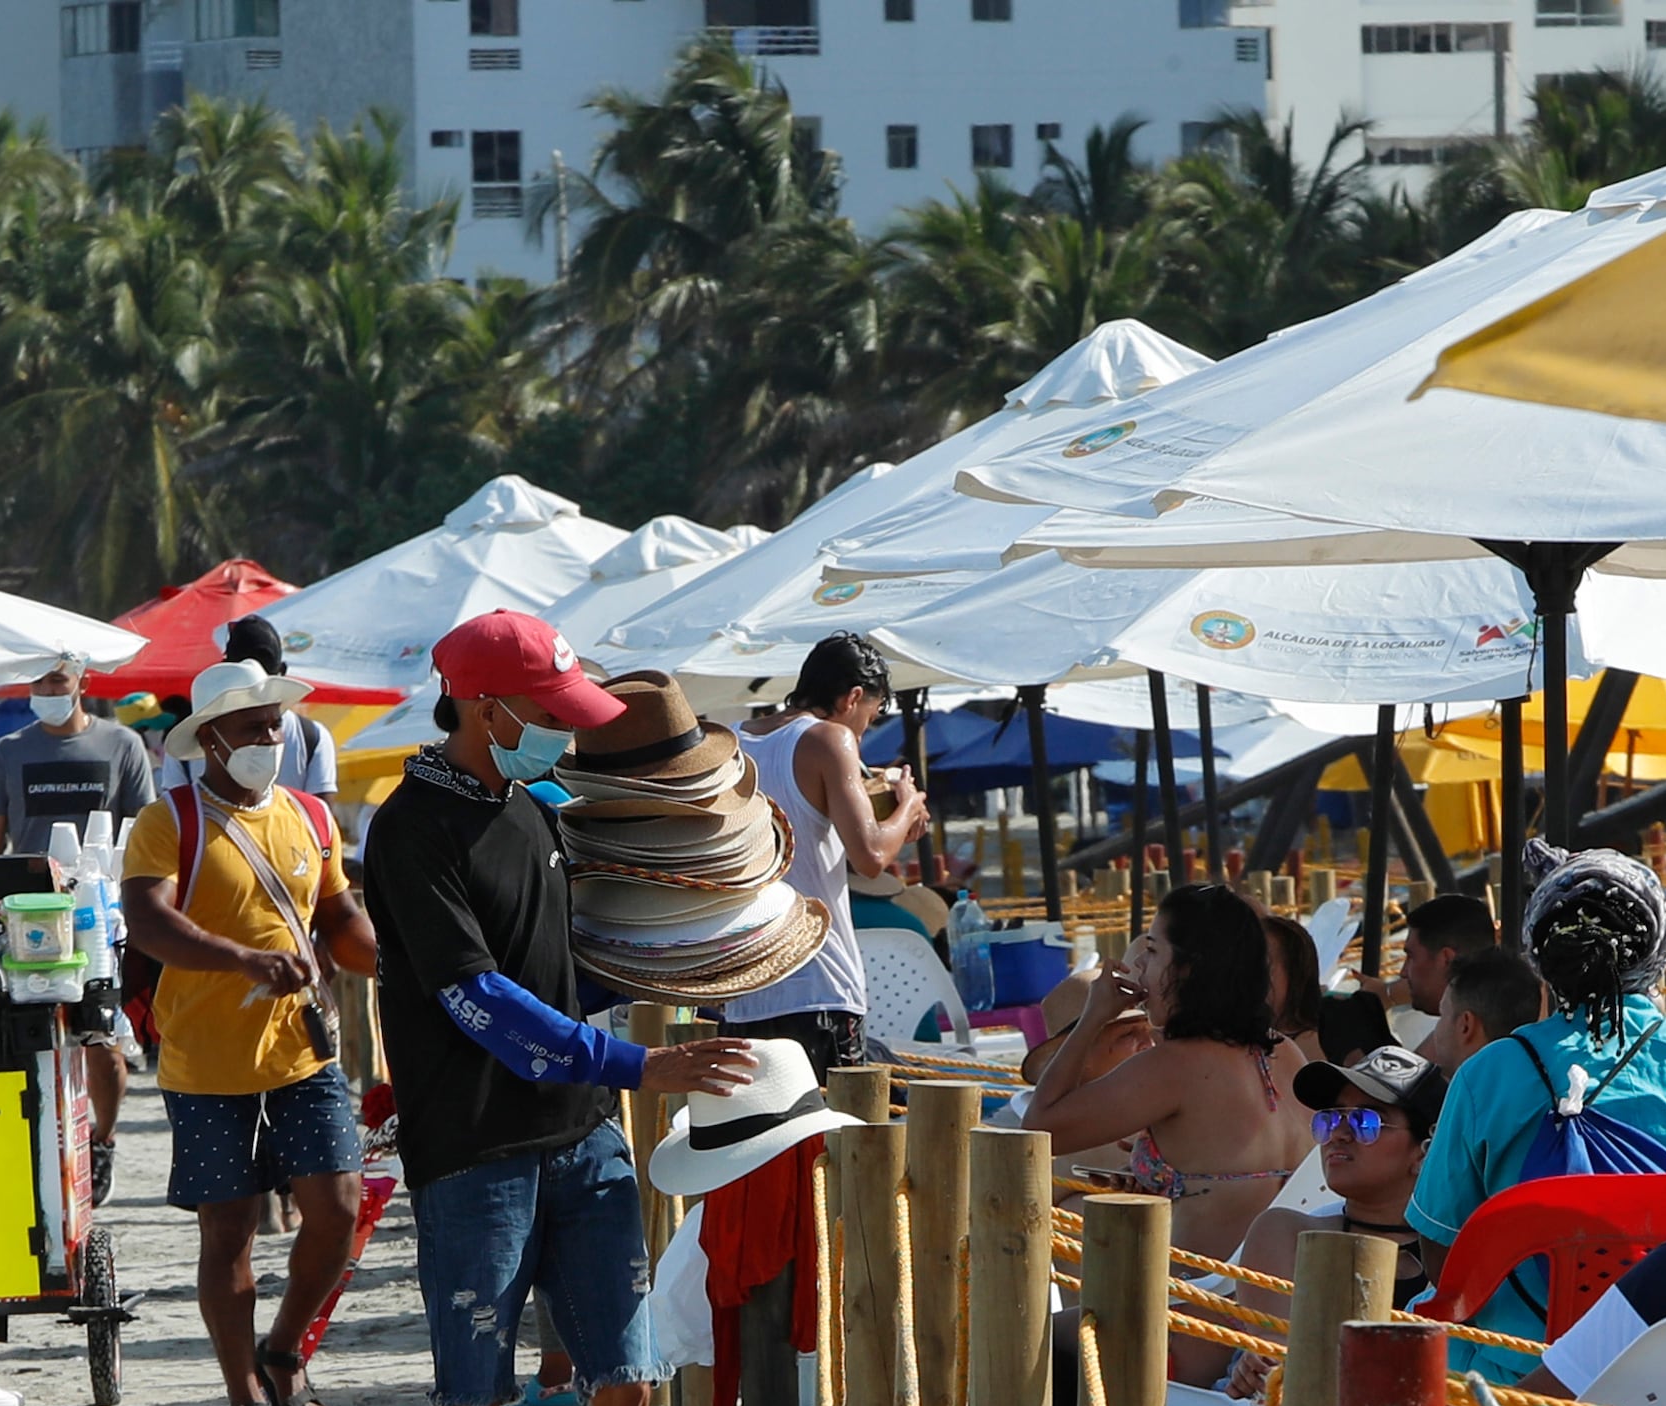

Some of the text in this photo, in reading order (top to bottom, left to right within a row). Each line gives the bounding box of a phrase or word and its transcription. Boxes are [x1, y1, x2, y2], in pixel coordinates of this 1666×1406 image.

[1263, 629, 1446, 649] ALCALDÍA DE LA LOCALIDAD
[28, 782, 105, 794] CALVIN KLEIN JEANS
